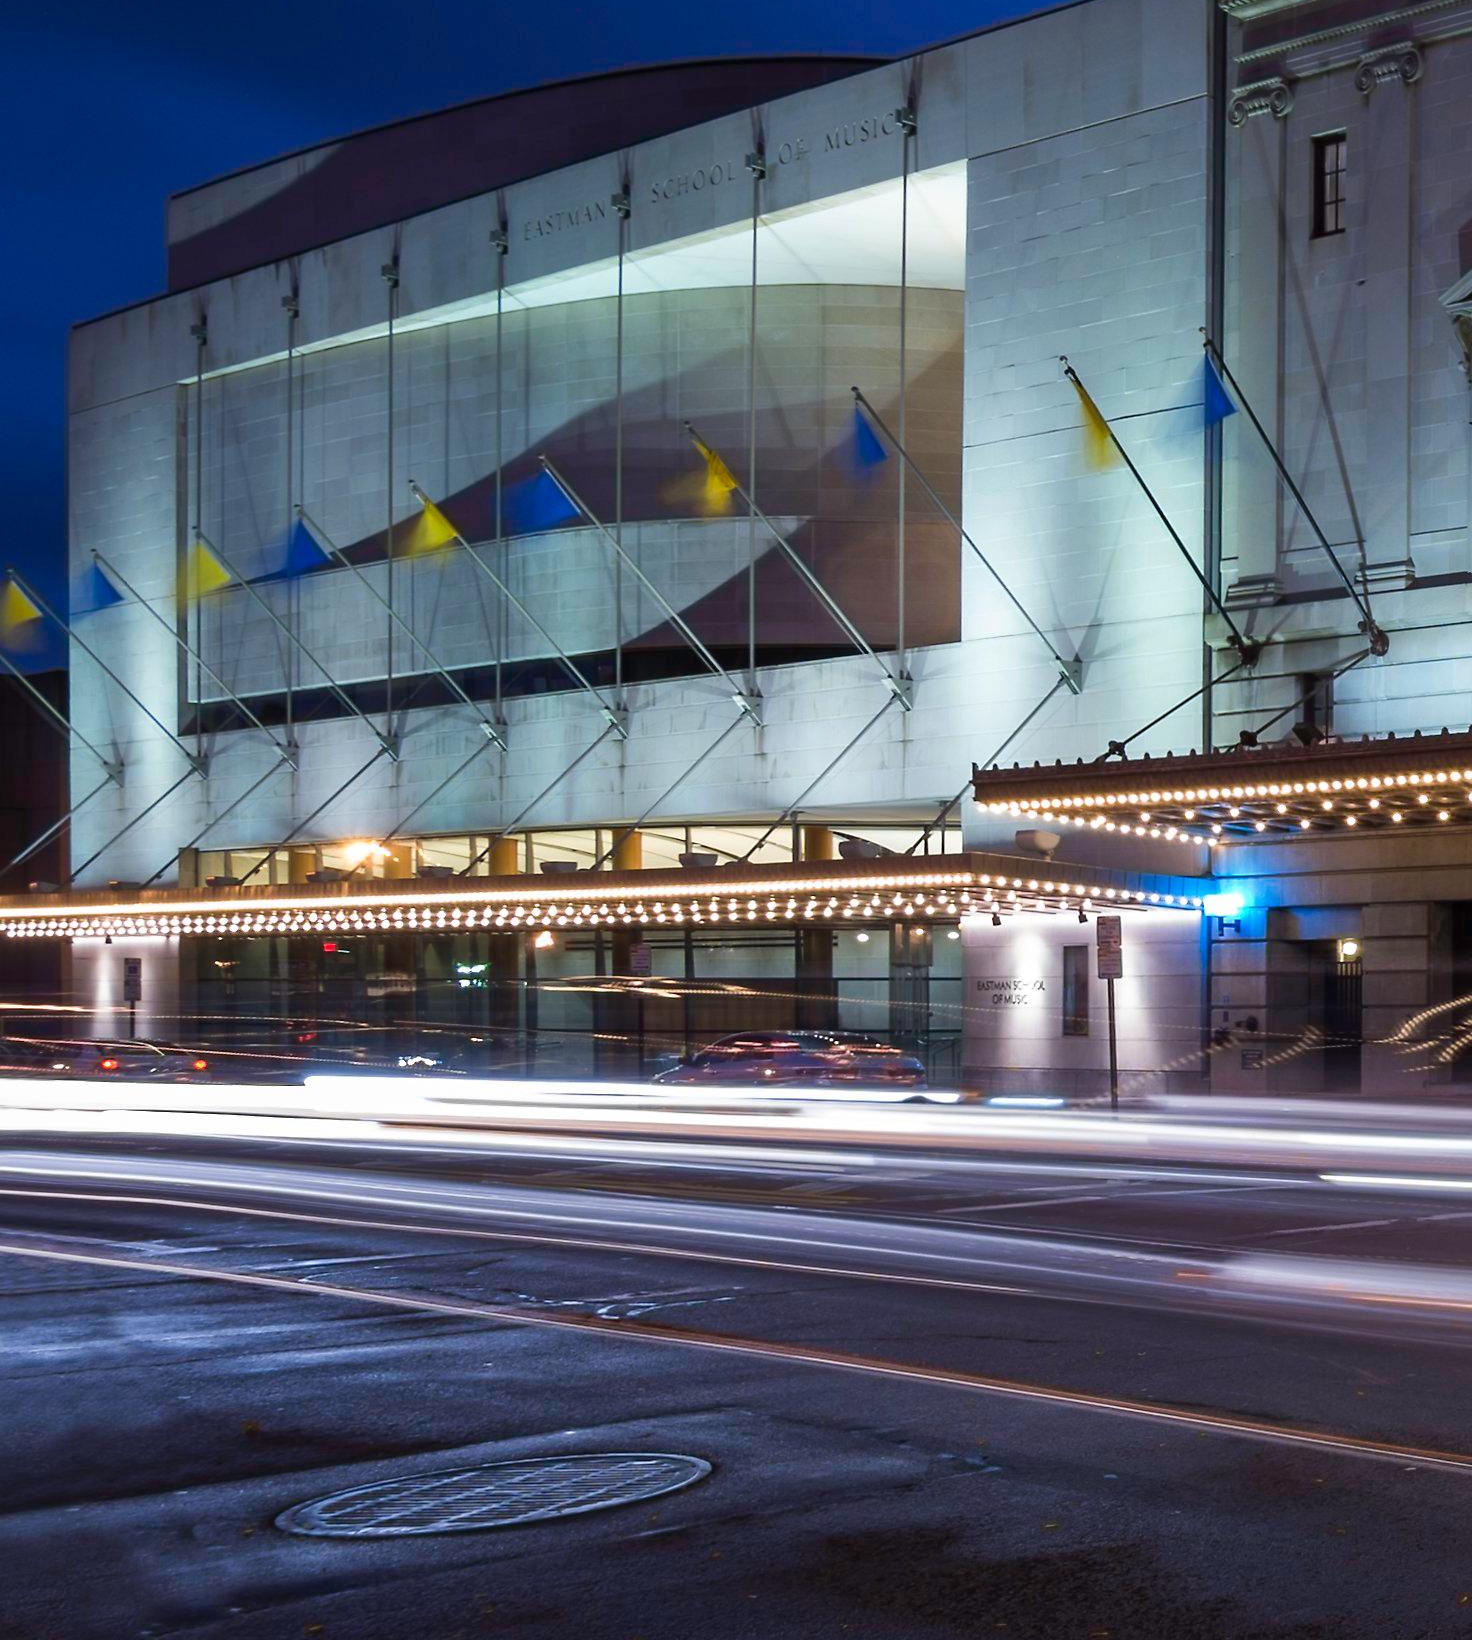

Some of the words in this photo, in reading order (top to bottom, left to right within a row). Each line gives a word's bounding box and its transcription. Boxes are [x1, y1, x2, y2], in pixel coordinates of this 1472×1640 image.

[524, 200, 608, 241] EASTMAN
[651, 161, 736, 203] SCHOOL
[778, 137, 810, 165] OF
[824, 112, 896, 153] MUSIC
[977, 980, 1011, 991] EASTMAN
[992, 994, 1003, 1004] OF
